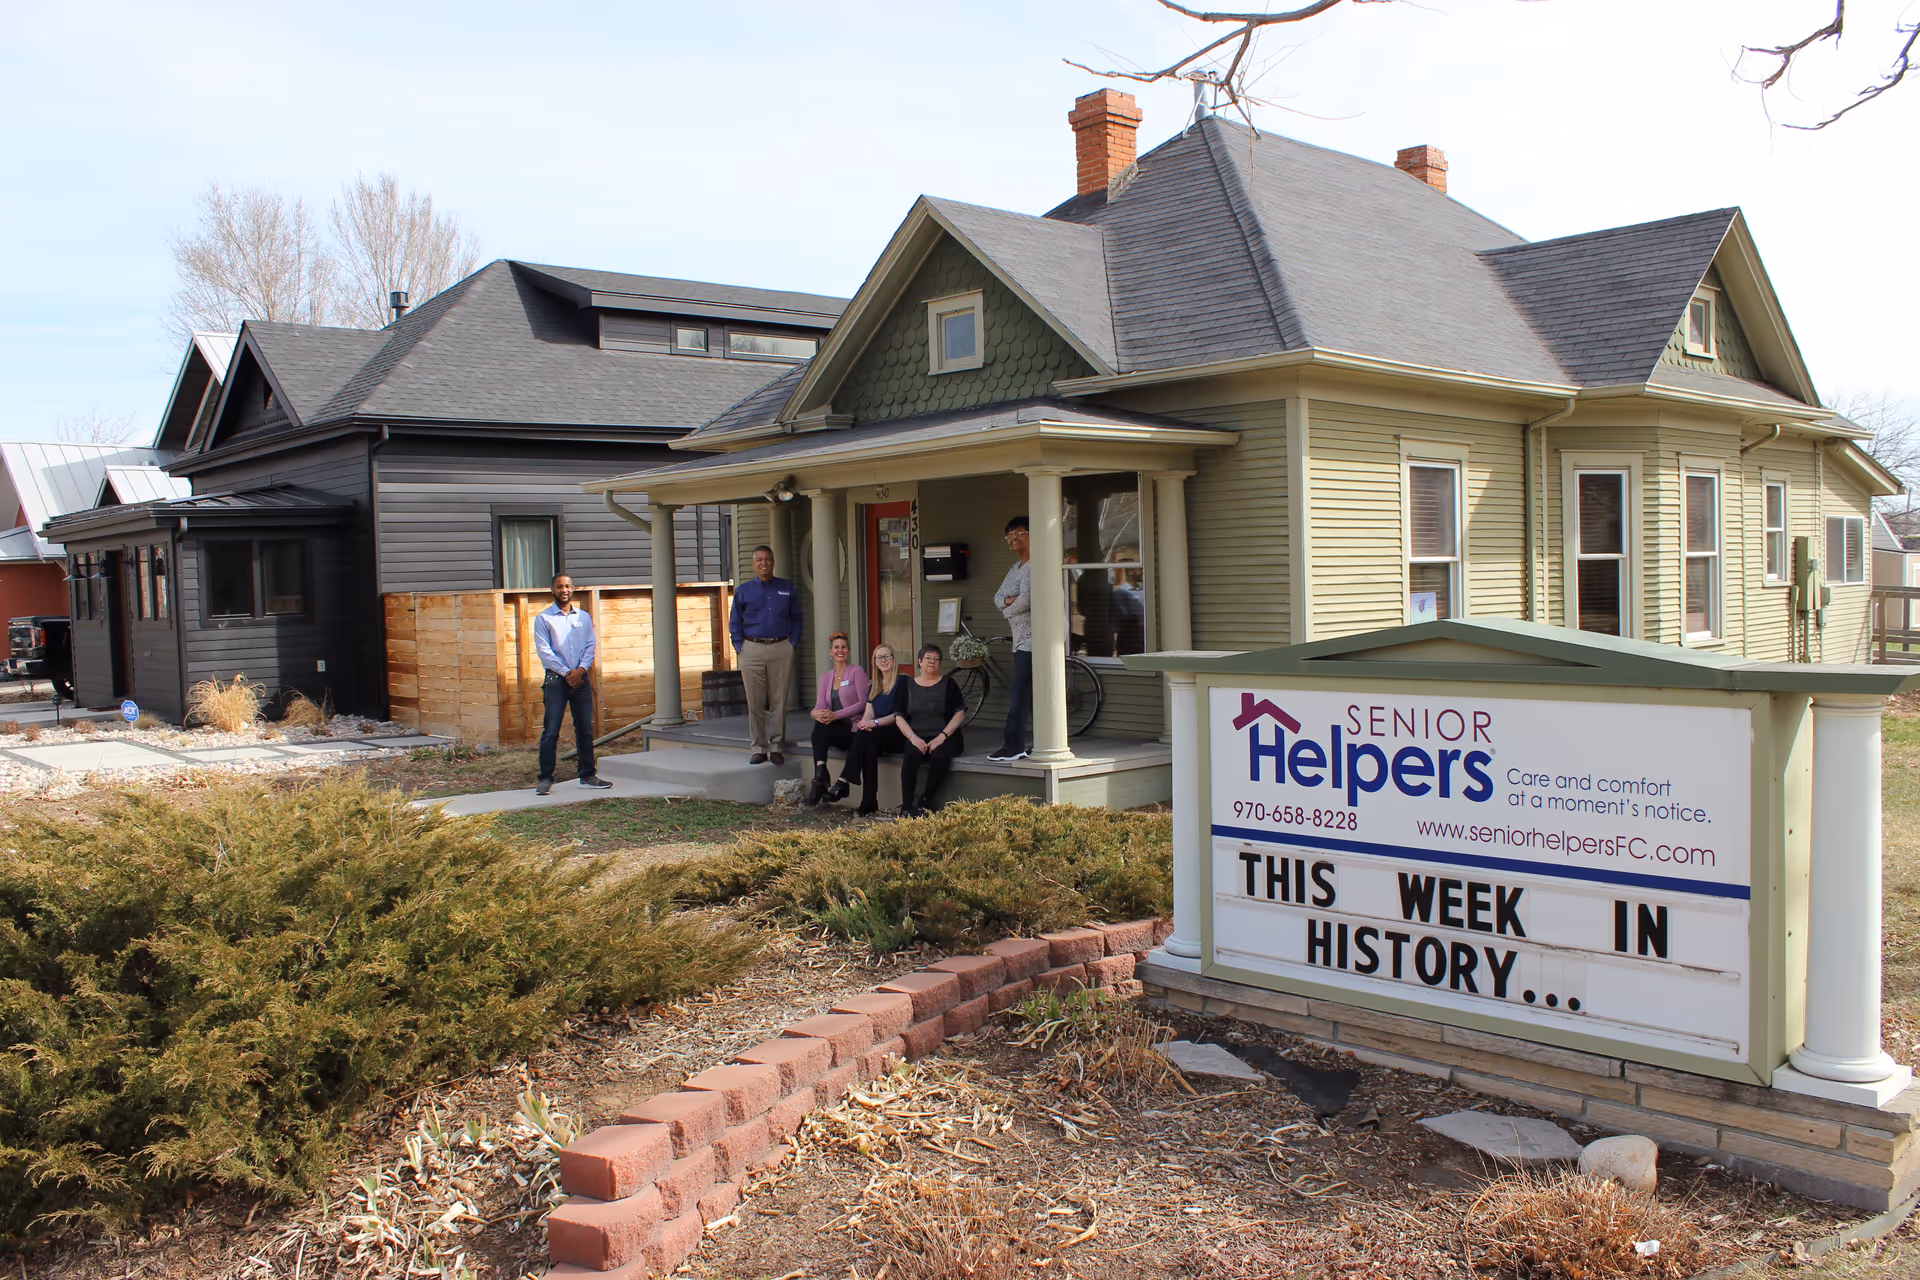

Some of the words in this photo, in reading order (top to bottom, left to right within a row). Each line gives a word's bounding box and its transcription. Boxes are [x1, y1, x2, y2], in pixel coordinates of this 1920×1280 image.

[1346, 704, 1492, 744] SENIOR
[1249, 723, 1494, 808] Helpers
[1506, 768, 1551, 788] Care
[1555, 775, 1592, 791] and
[1597, 778, 1672, 797] comfort
[1233, 800, 1358, 832] 970-658-8228
[1507, 792, 1526, 807] at
[1530, 795, 1543, 809] a
[1547, 797, 1639, 818] moment's
[1644, 803, 1712, 824] notice.
[1416, 820, 1716, 867] www.seniorhelpersFC.com
[1238, 851, 1337, 908] THIS
[1397, 871, 1527, 938] WEEK
[1614, 899, 1668, 959] IN
[1307, 918, 1581, 1012] HISTORY...
